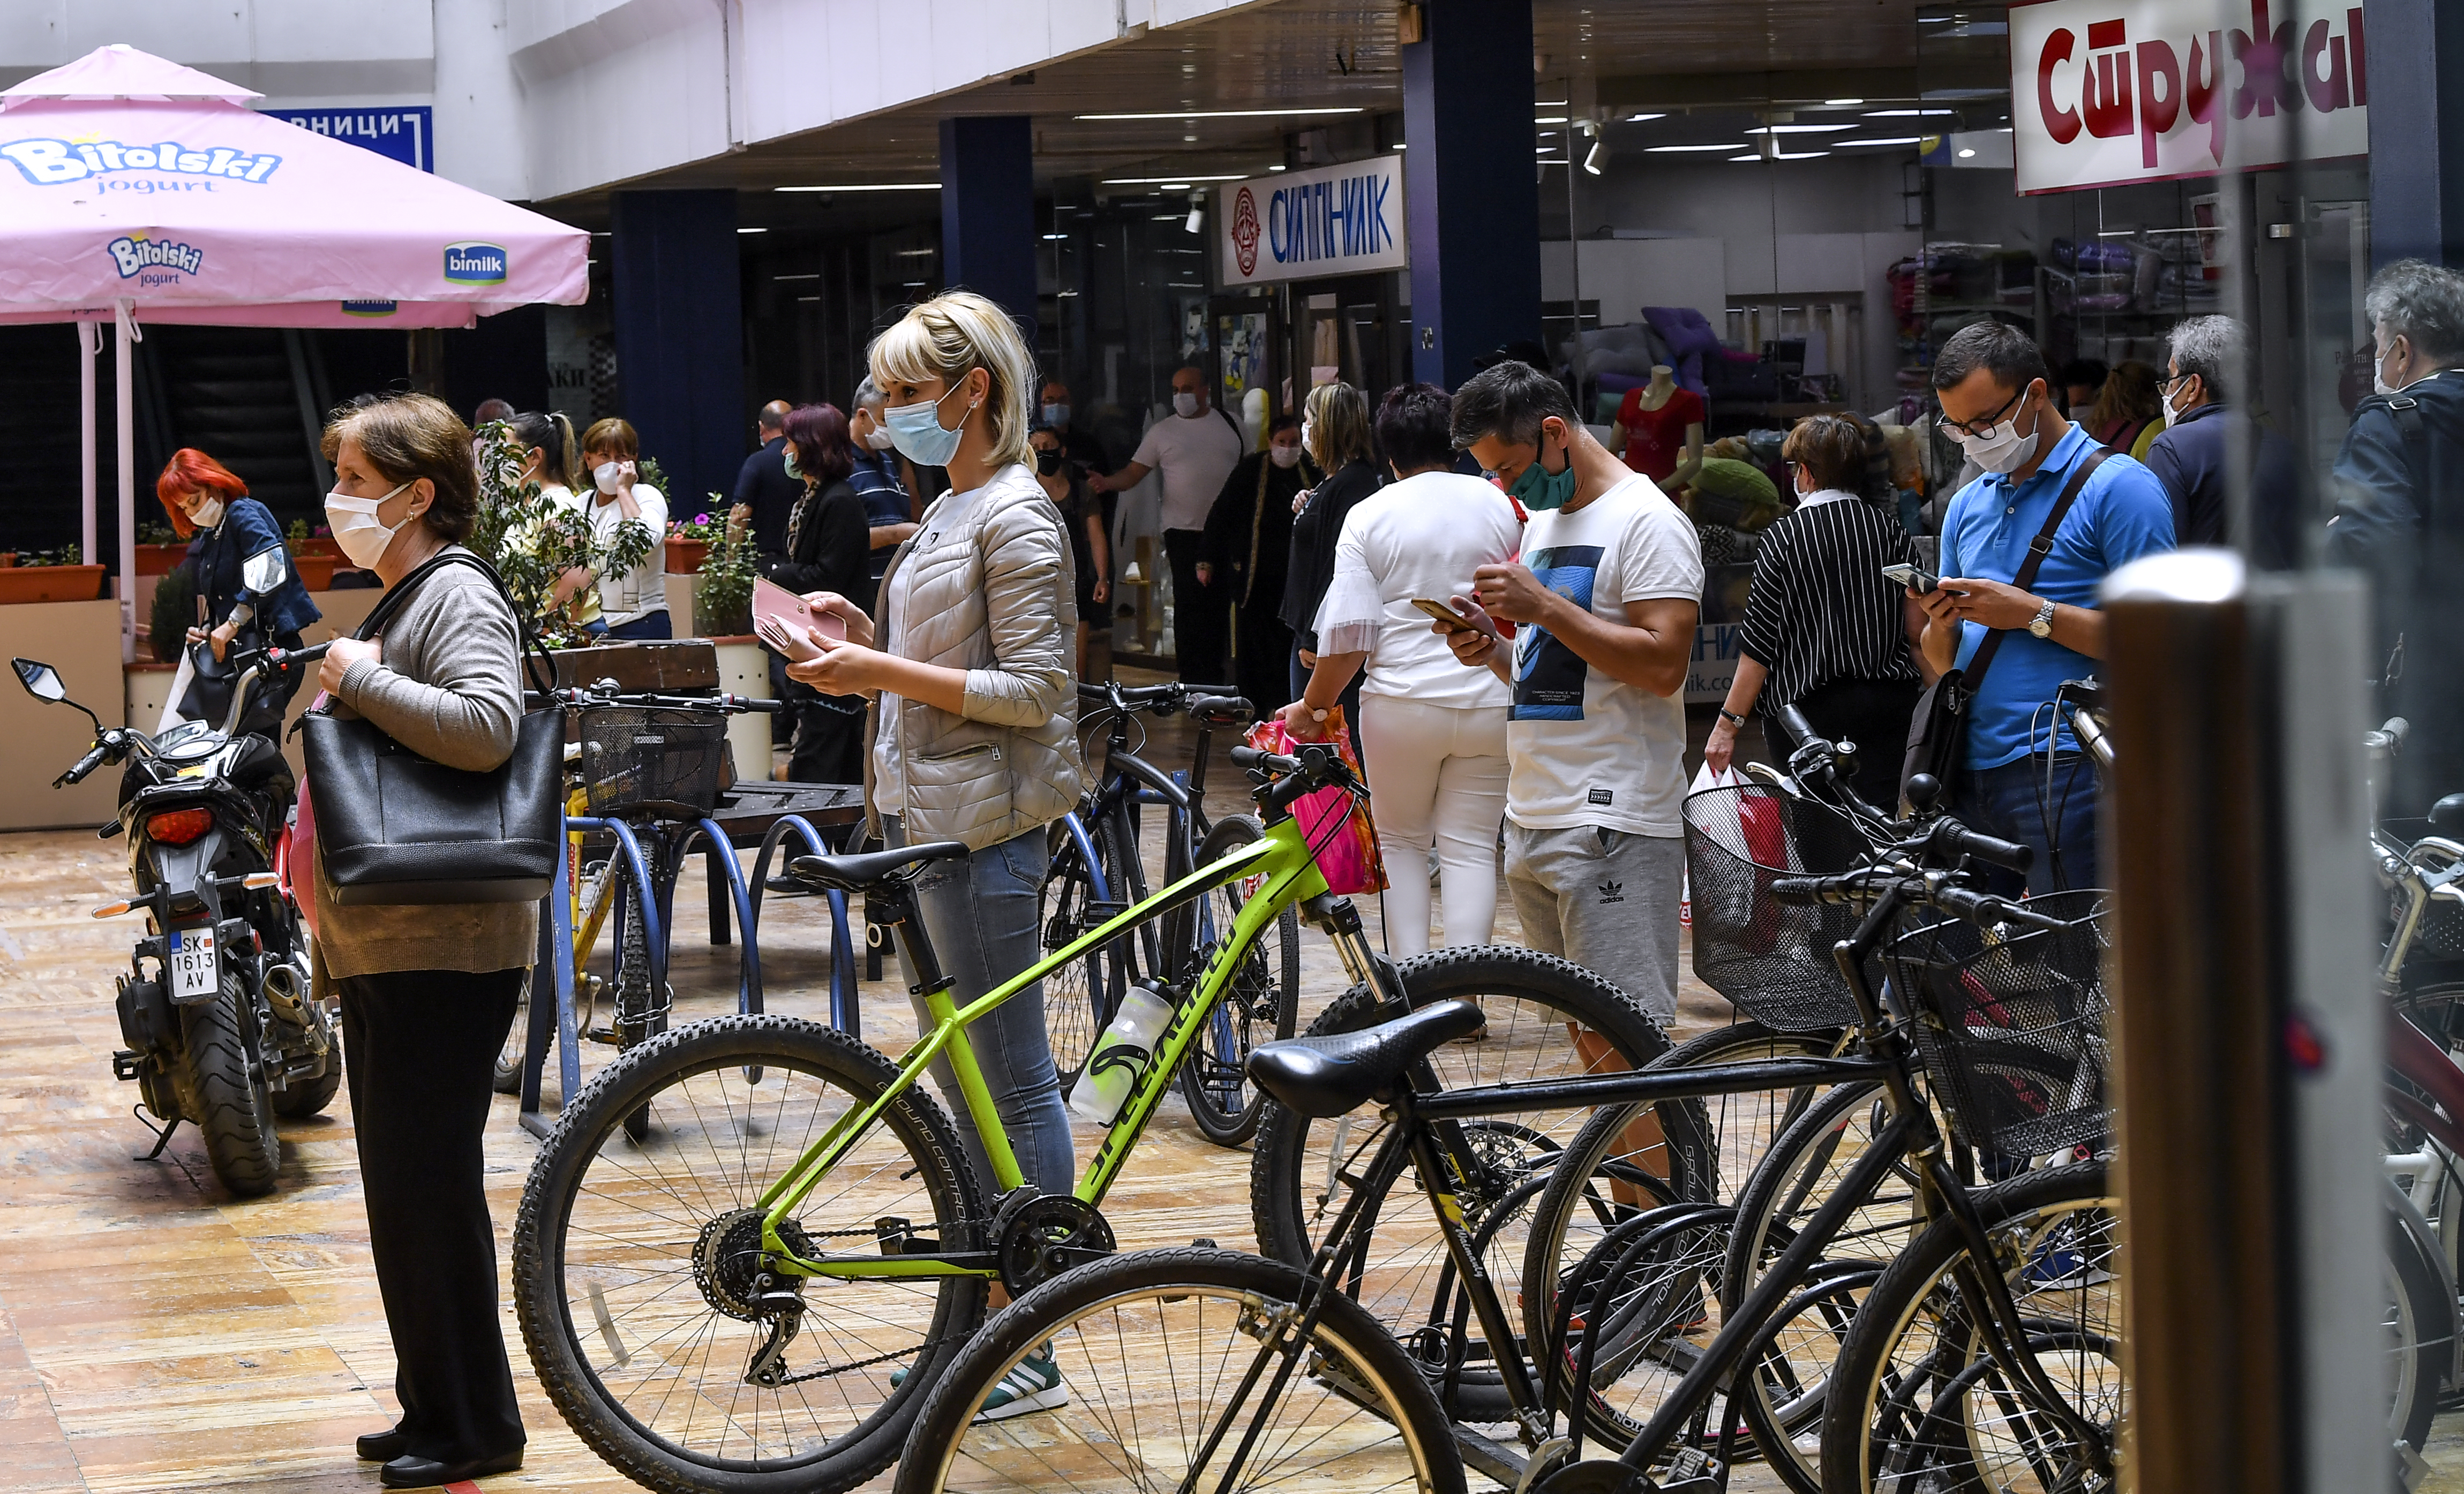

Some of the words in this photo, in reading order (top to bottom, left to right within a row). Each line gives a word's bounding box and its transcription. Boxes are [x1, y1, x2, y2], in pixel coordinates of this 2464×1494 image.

[0, 138, 282, 185] Bitolski
[98, 176, 219, 194] jogurt
[1269, 173, 1392, 263] СИТНИК
[108, 236, 202, 278] Bitolski
[450, 255, 502, 271] bimilk
[140, 271, 180, 287] jogurt
[1599, 896, 1624, 904] adidas
[183, 935, 202, 952] SK
[176, 953, 214, 972] 1613
[186, 971, 204, 989] AV
[876, 1081, 936, 1142] GOUND
